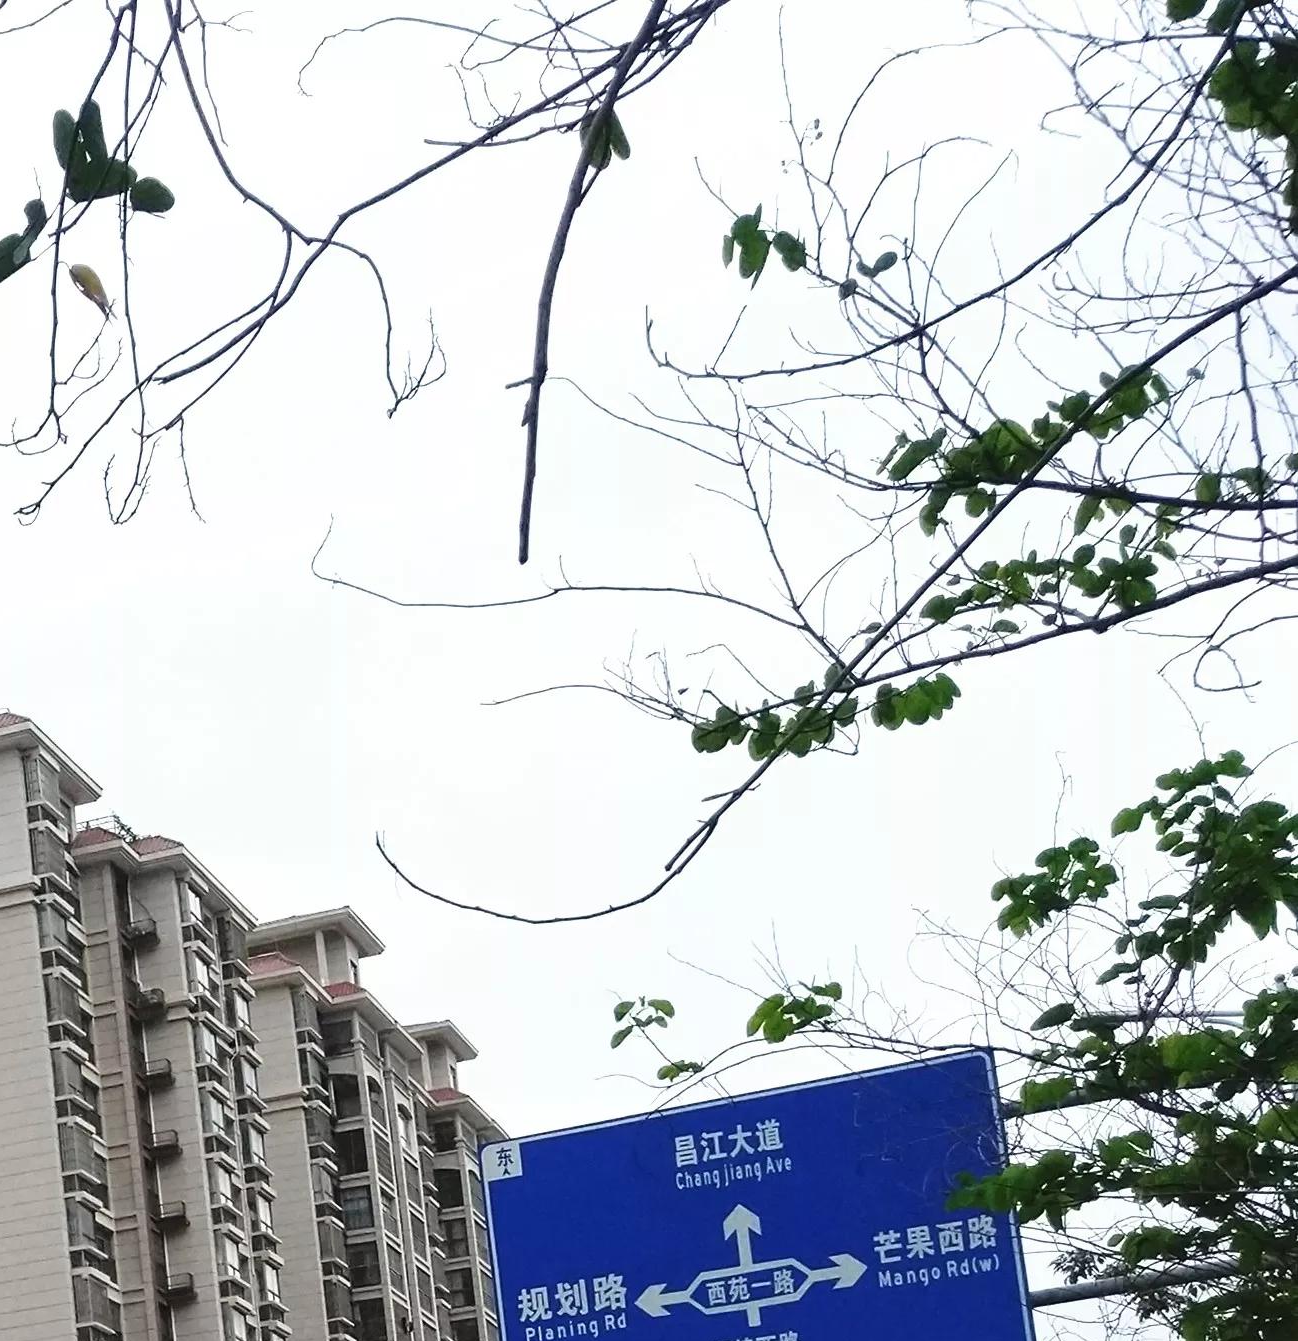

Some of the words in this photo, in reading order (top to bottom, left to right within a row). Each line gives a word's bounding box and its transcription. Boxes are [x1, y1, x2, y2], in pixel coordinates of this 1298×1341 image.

[496, 1147, 515, 1167] 东
[674, 1118, 784, 1168] 昌江大道
[765, 1155, 793, 1175] Ave
[873, 1213, 998, 1264] 芒果西路
[705, 1268, 796, 1306] 西苑一路
[878, 1266, 941, 1288] Mango
[517, 1272, 628, 1323] 规划路
[603, 1311, 628, 1332] Rd
